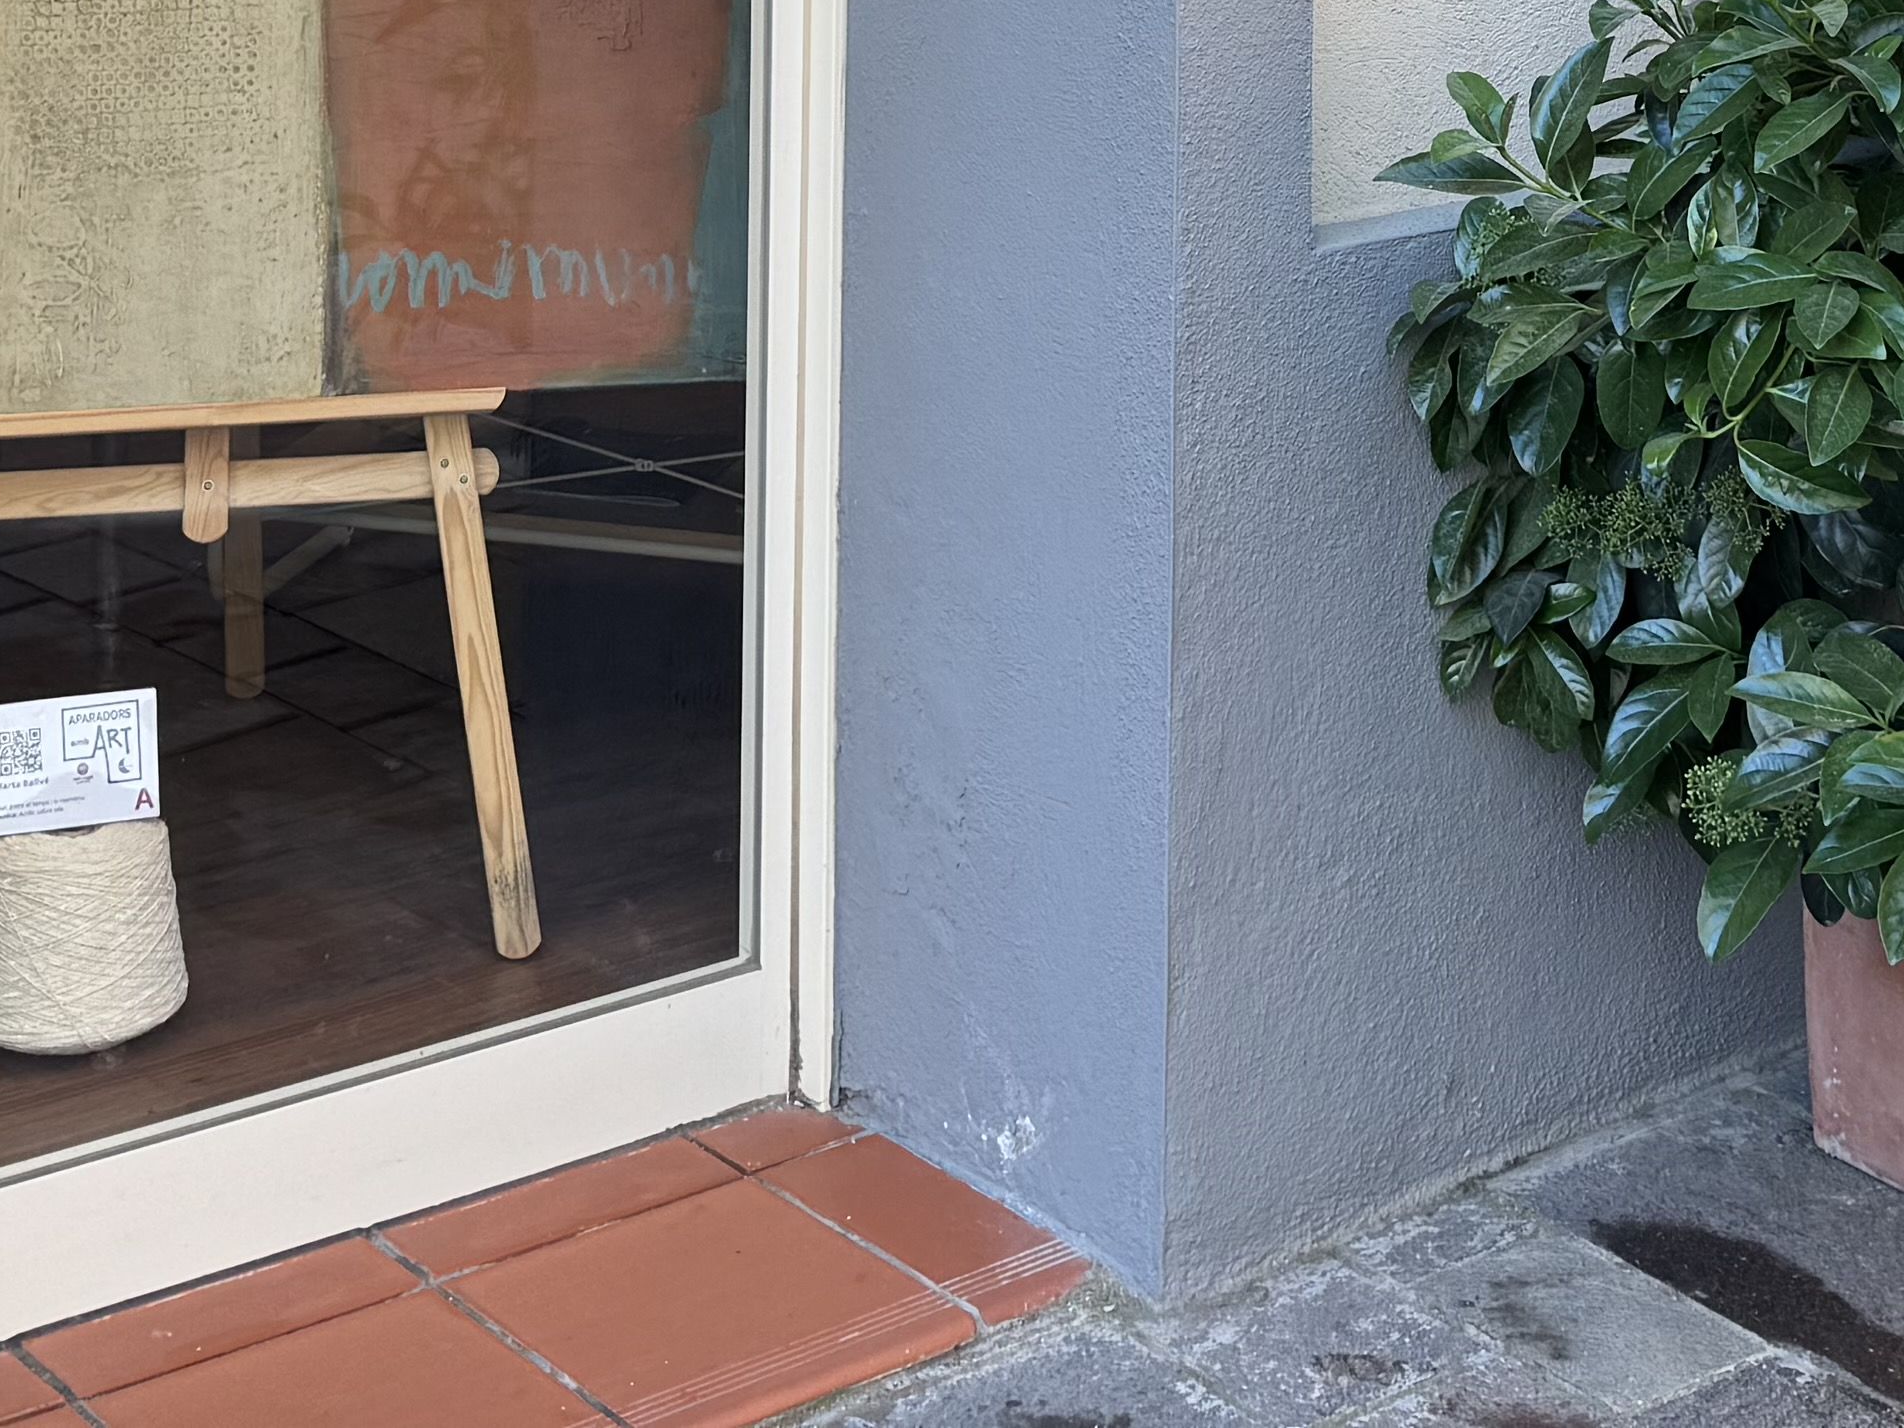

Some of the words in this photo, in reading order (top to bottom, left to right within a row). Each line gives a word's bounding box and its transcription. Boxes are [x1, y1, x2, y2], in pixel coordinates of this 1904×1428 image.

[68, 708, 132, 726] APARADORS
[92, 724, 132, 757] ART
[135, 787, 154, 811] A
